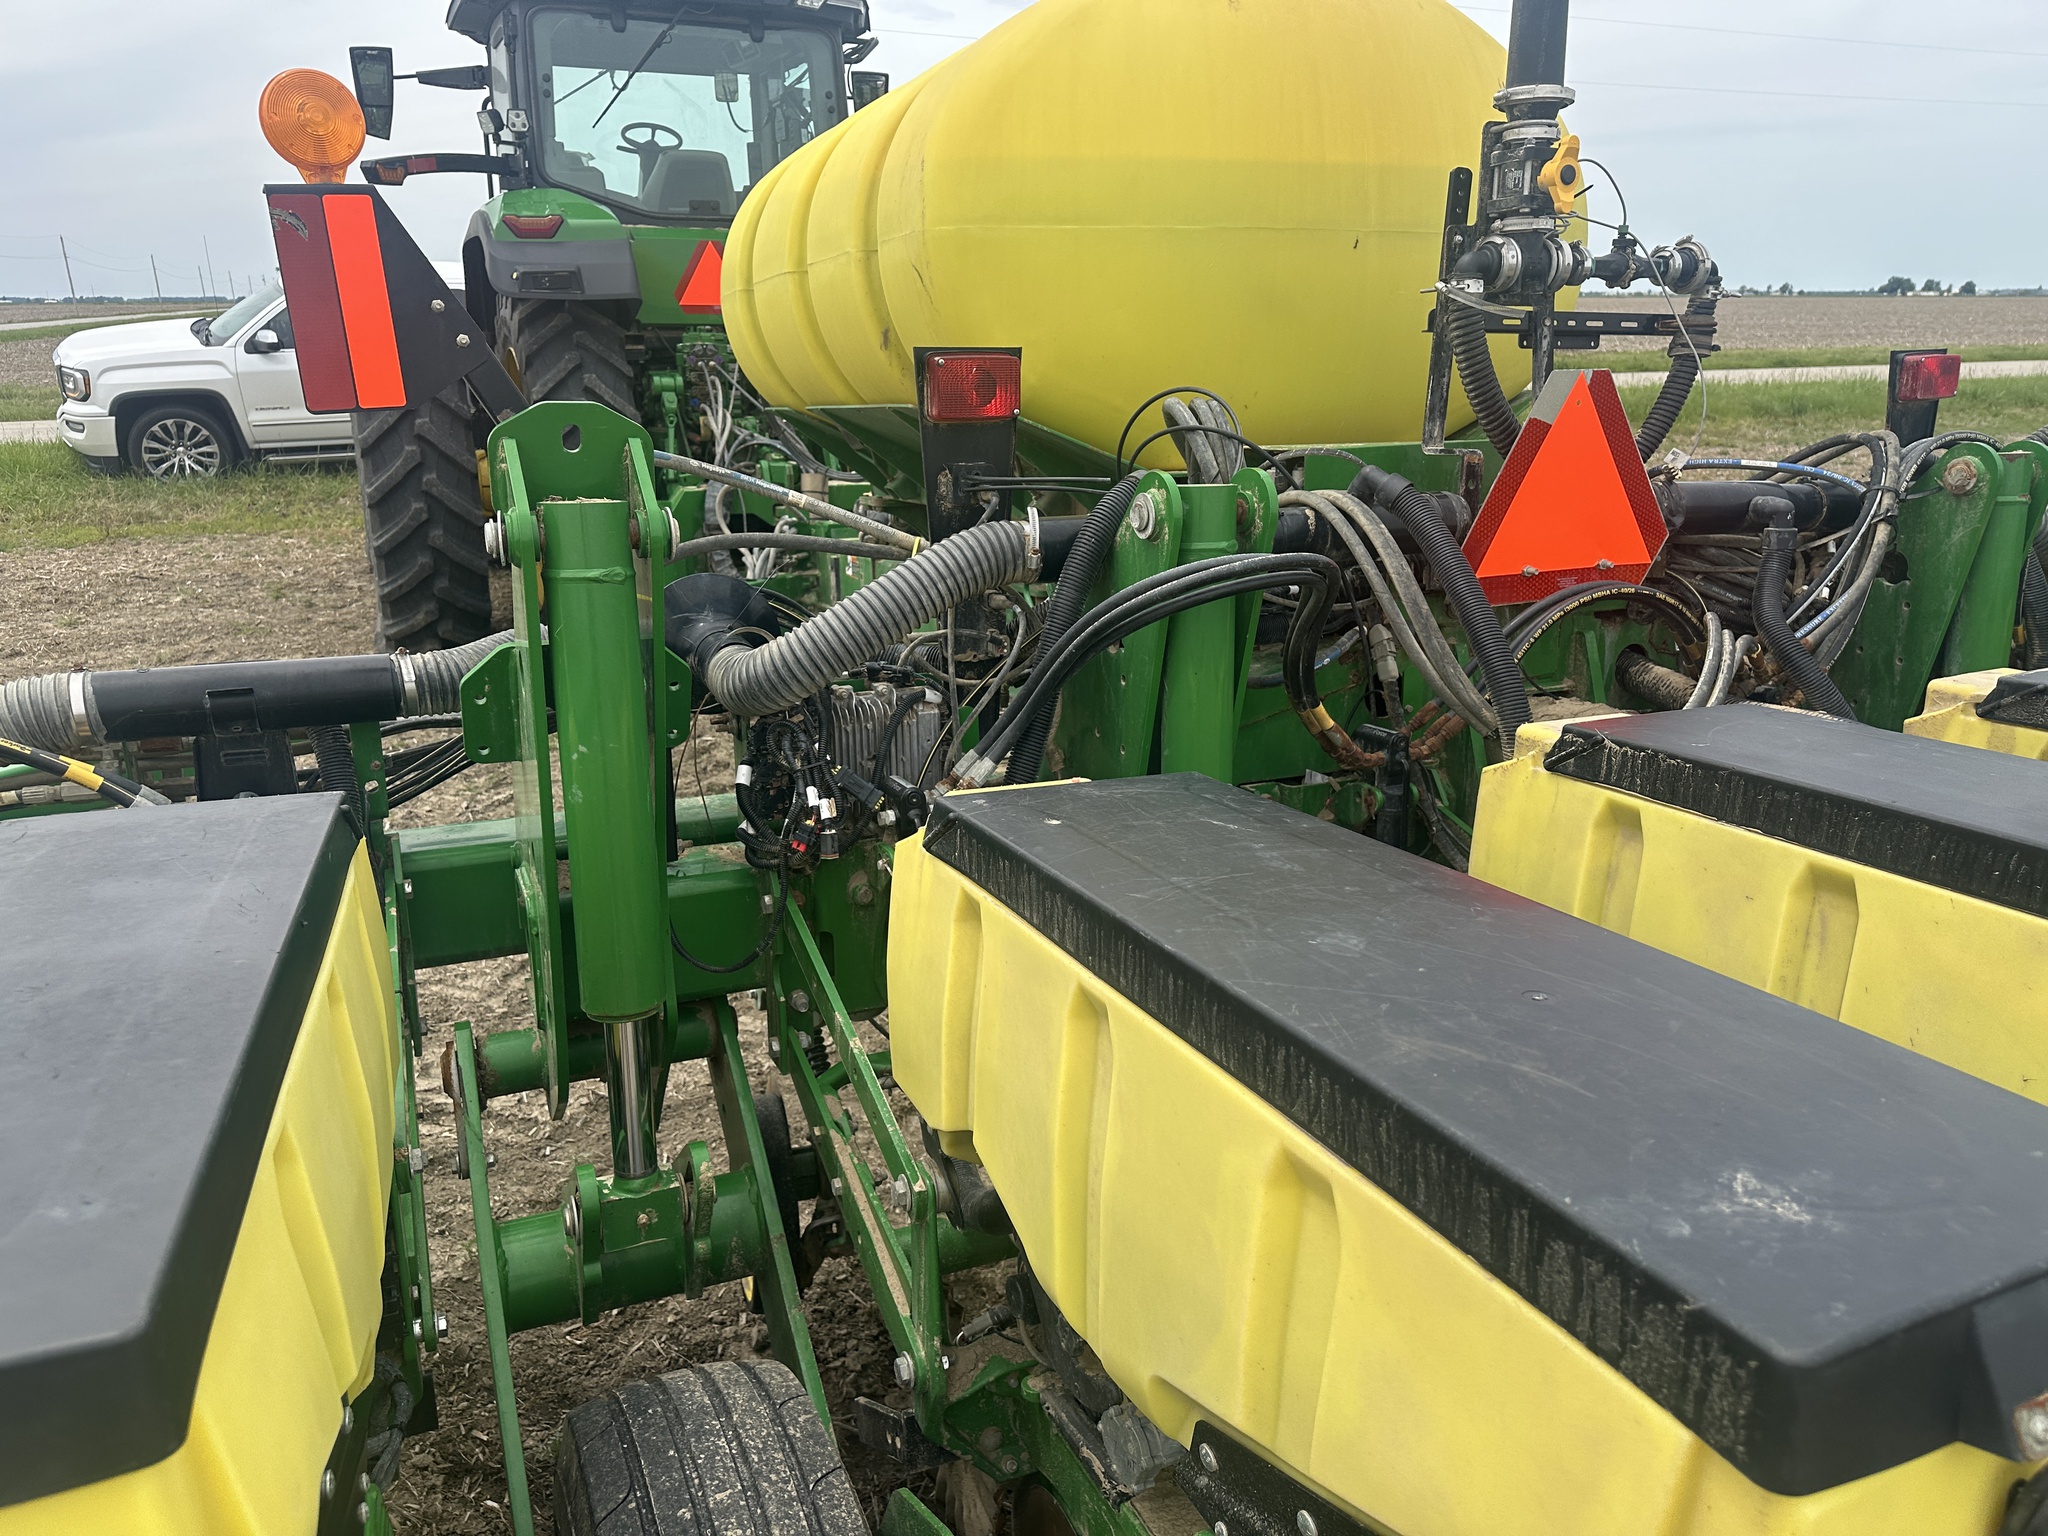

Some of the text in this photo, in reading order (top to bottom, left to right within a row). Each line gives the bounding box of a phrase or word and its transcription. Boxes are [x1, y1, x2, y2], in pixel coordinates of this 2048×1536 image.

[1533, 628, 1543, 639] WP
[1541, 619, 1553, 631] 21.0
[1552, 611, 1564, 622] MPa
[1592, 589, 1611, 599] MSHA
